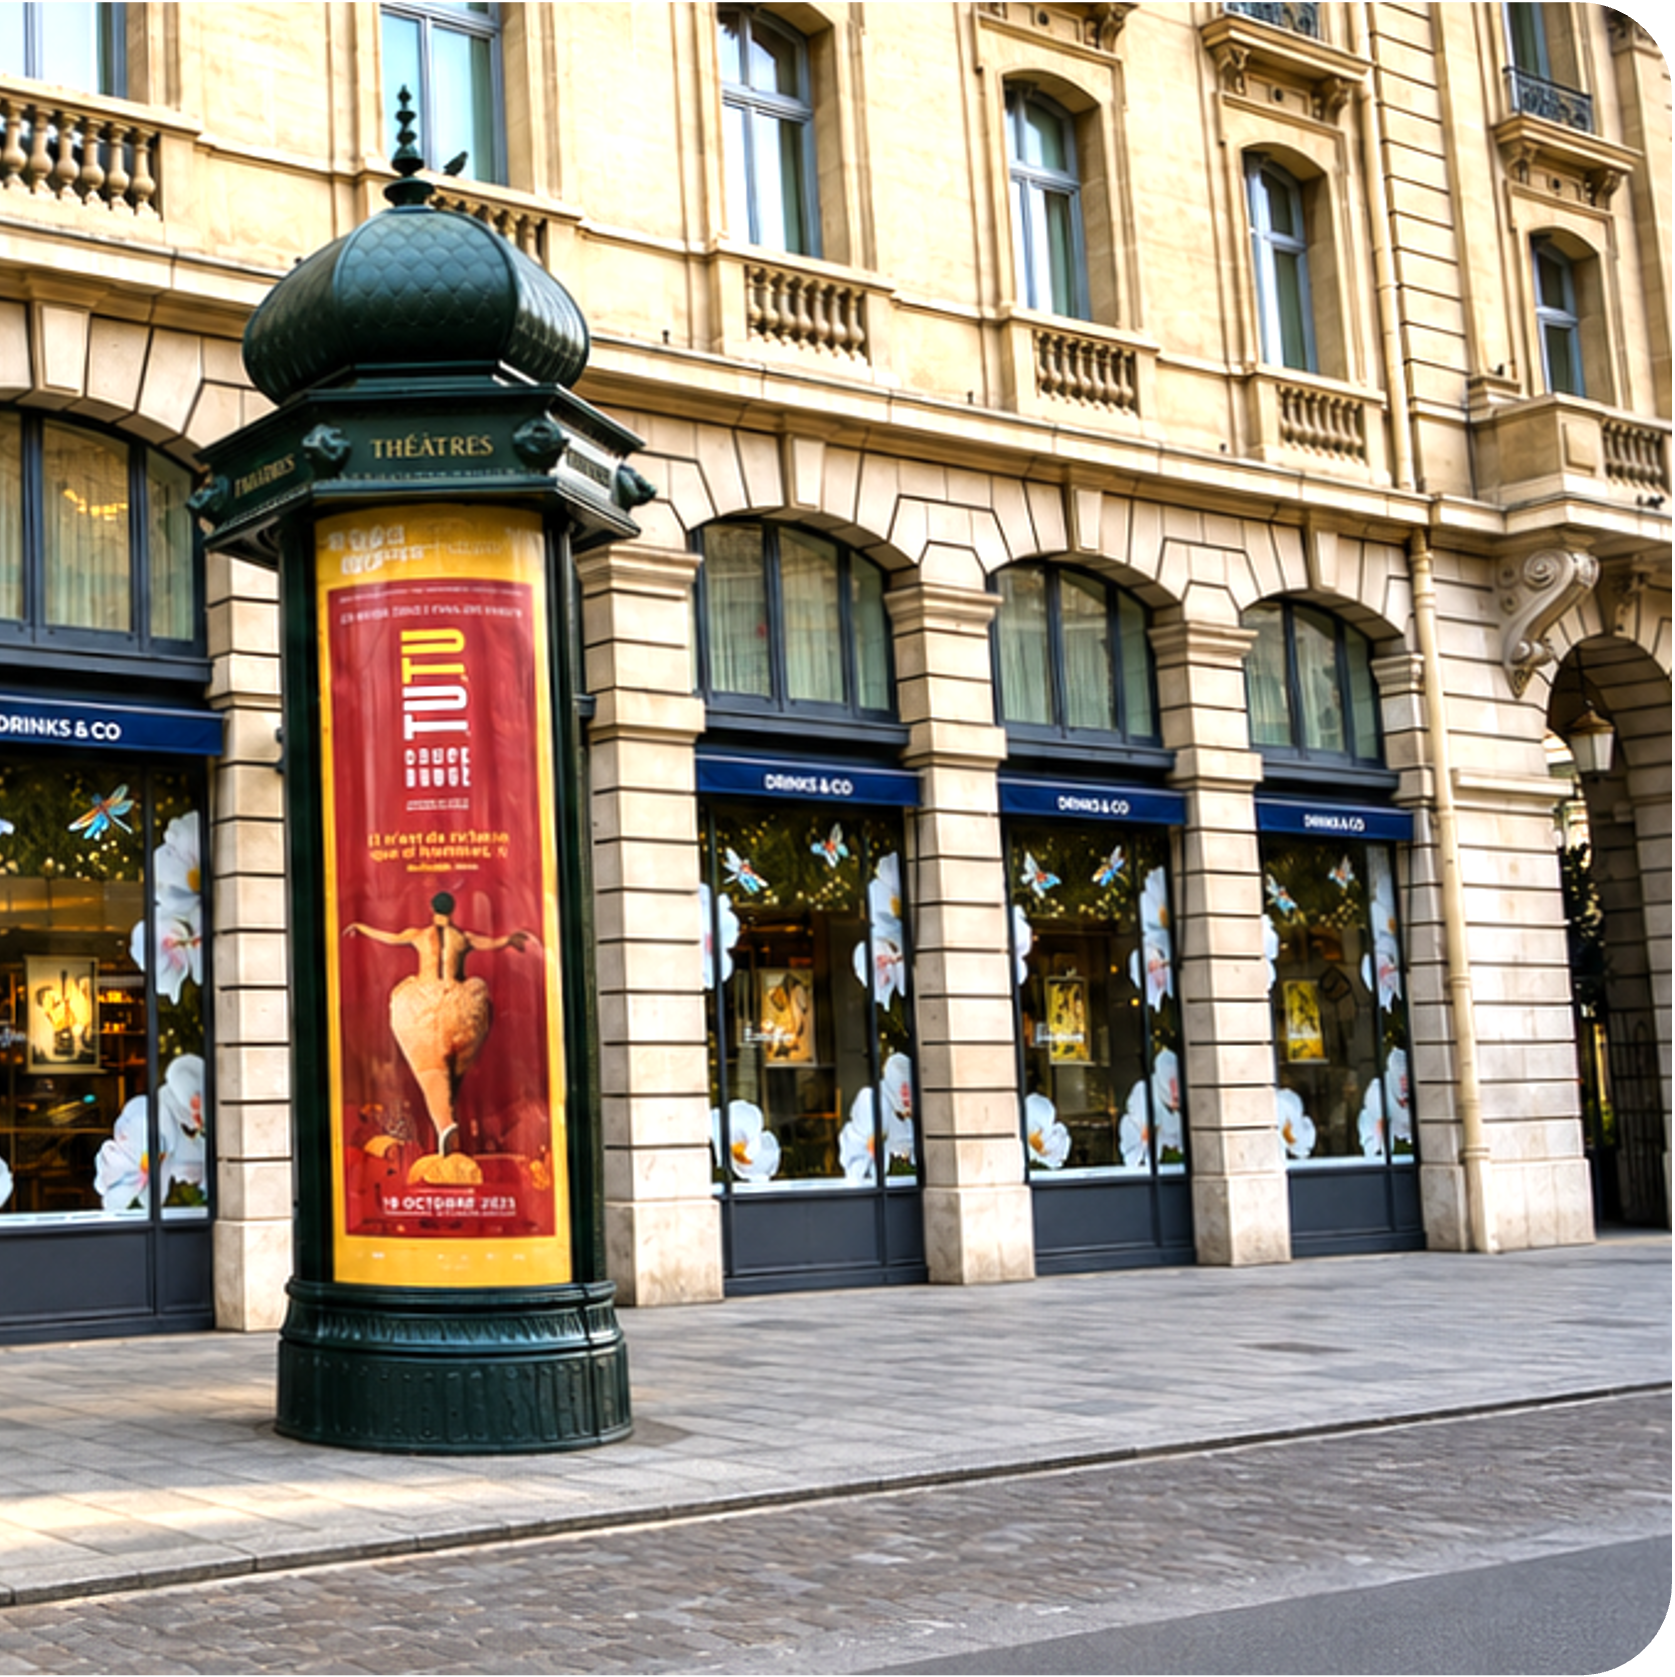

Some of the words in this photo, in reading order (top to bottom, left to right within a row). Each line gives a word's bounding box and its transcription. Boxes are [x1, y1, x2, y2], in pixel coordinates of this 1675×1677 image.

[75, 719, 89, 739] &
[90, 721, 122, 741] CO
[830, 778, 854, 796] CO
